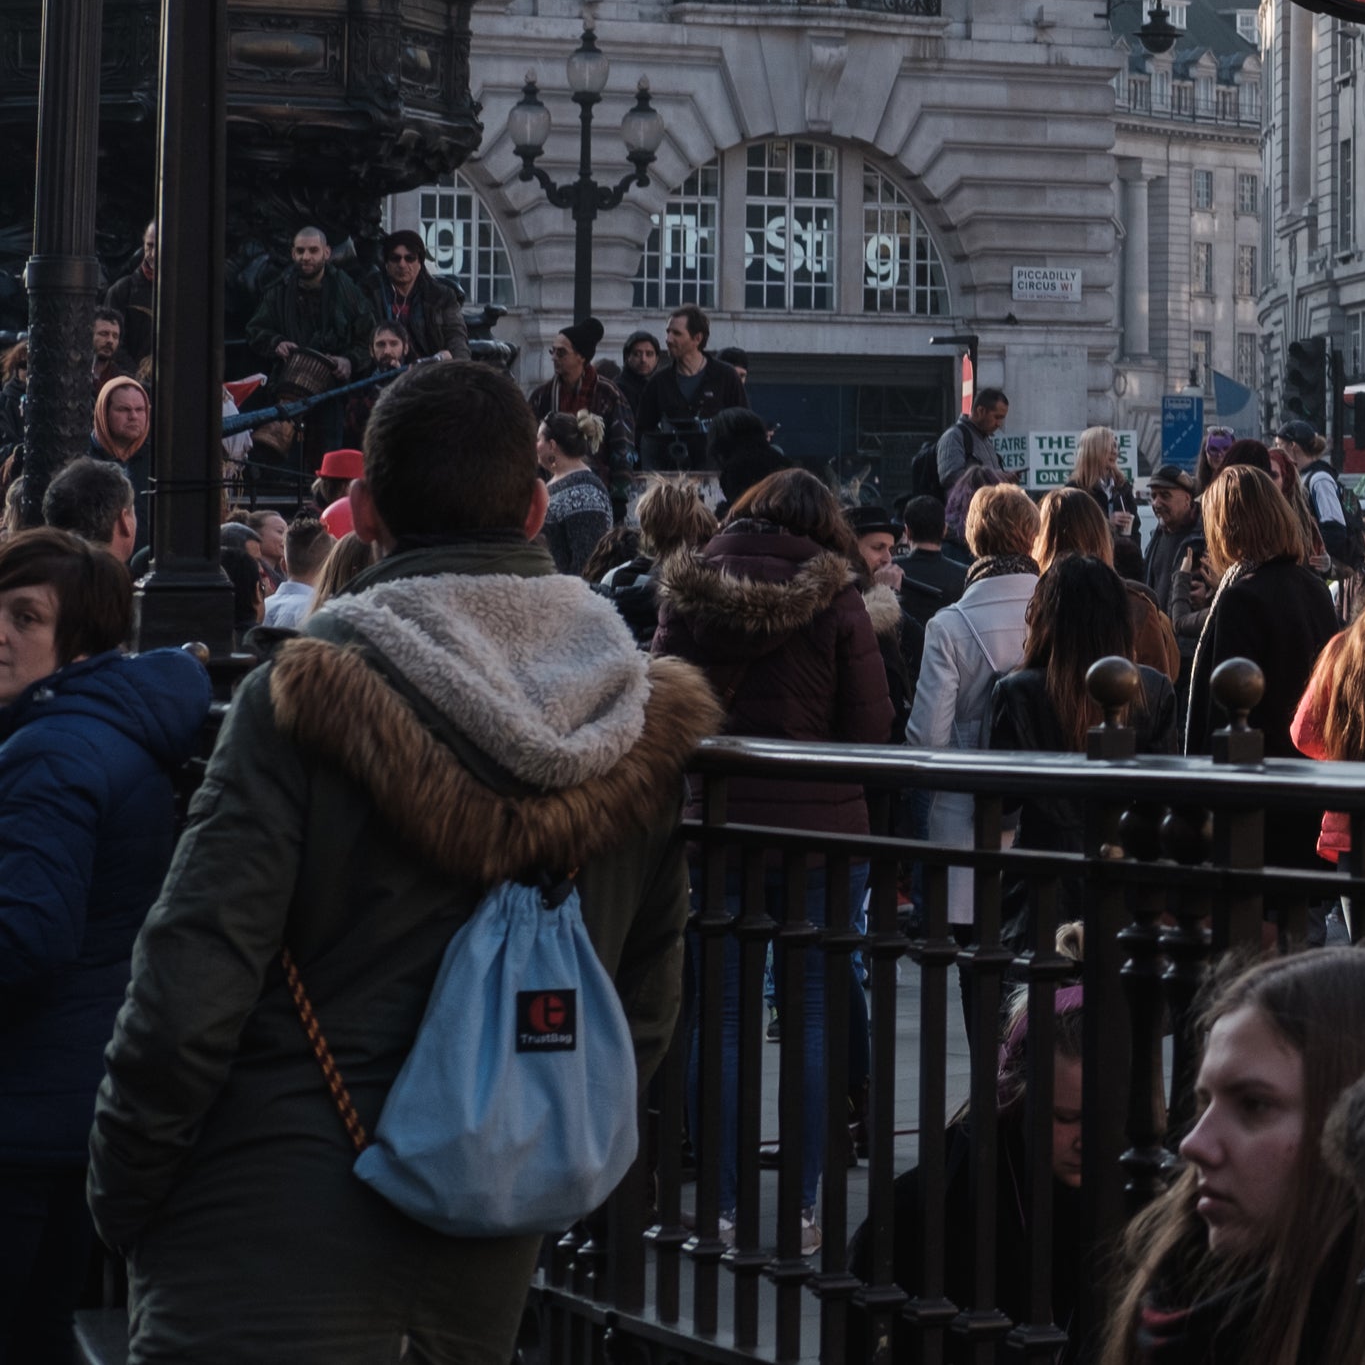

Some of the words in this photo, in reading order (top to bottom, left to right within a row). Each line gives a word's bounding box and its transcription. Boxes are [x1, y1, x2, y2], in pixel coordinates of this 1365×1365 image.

[1017, 270, 1076, 281] PICCADILLY
[1017, 281, 1057, 291] CIRCUS
[1040, 472, 1059, 483] ON
[520, 1033, 573, 1044] TrustBag
